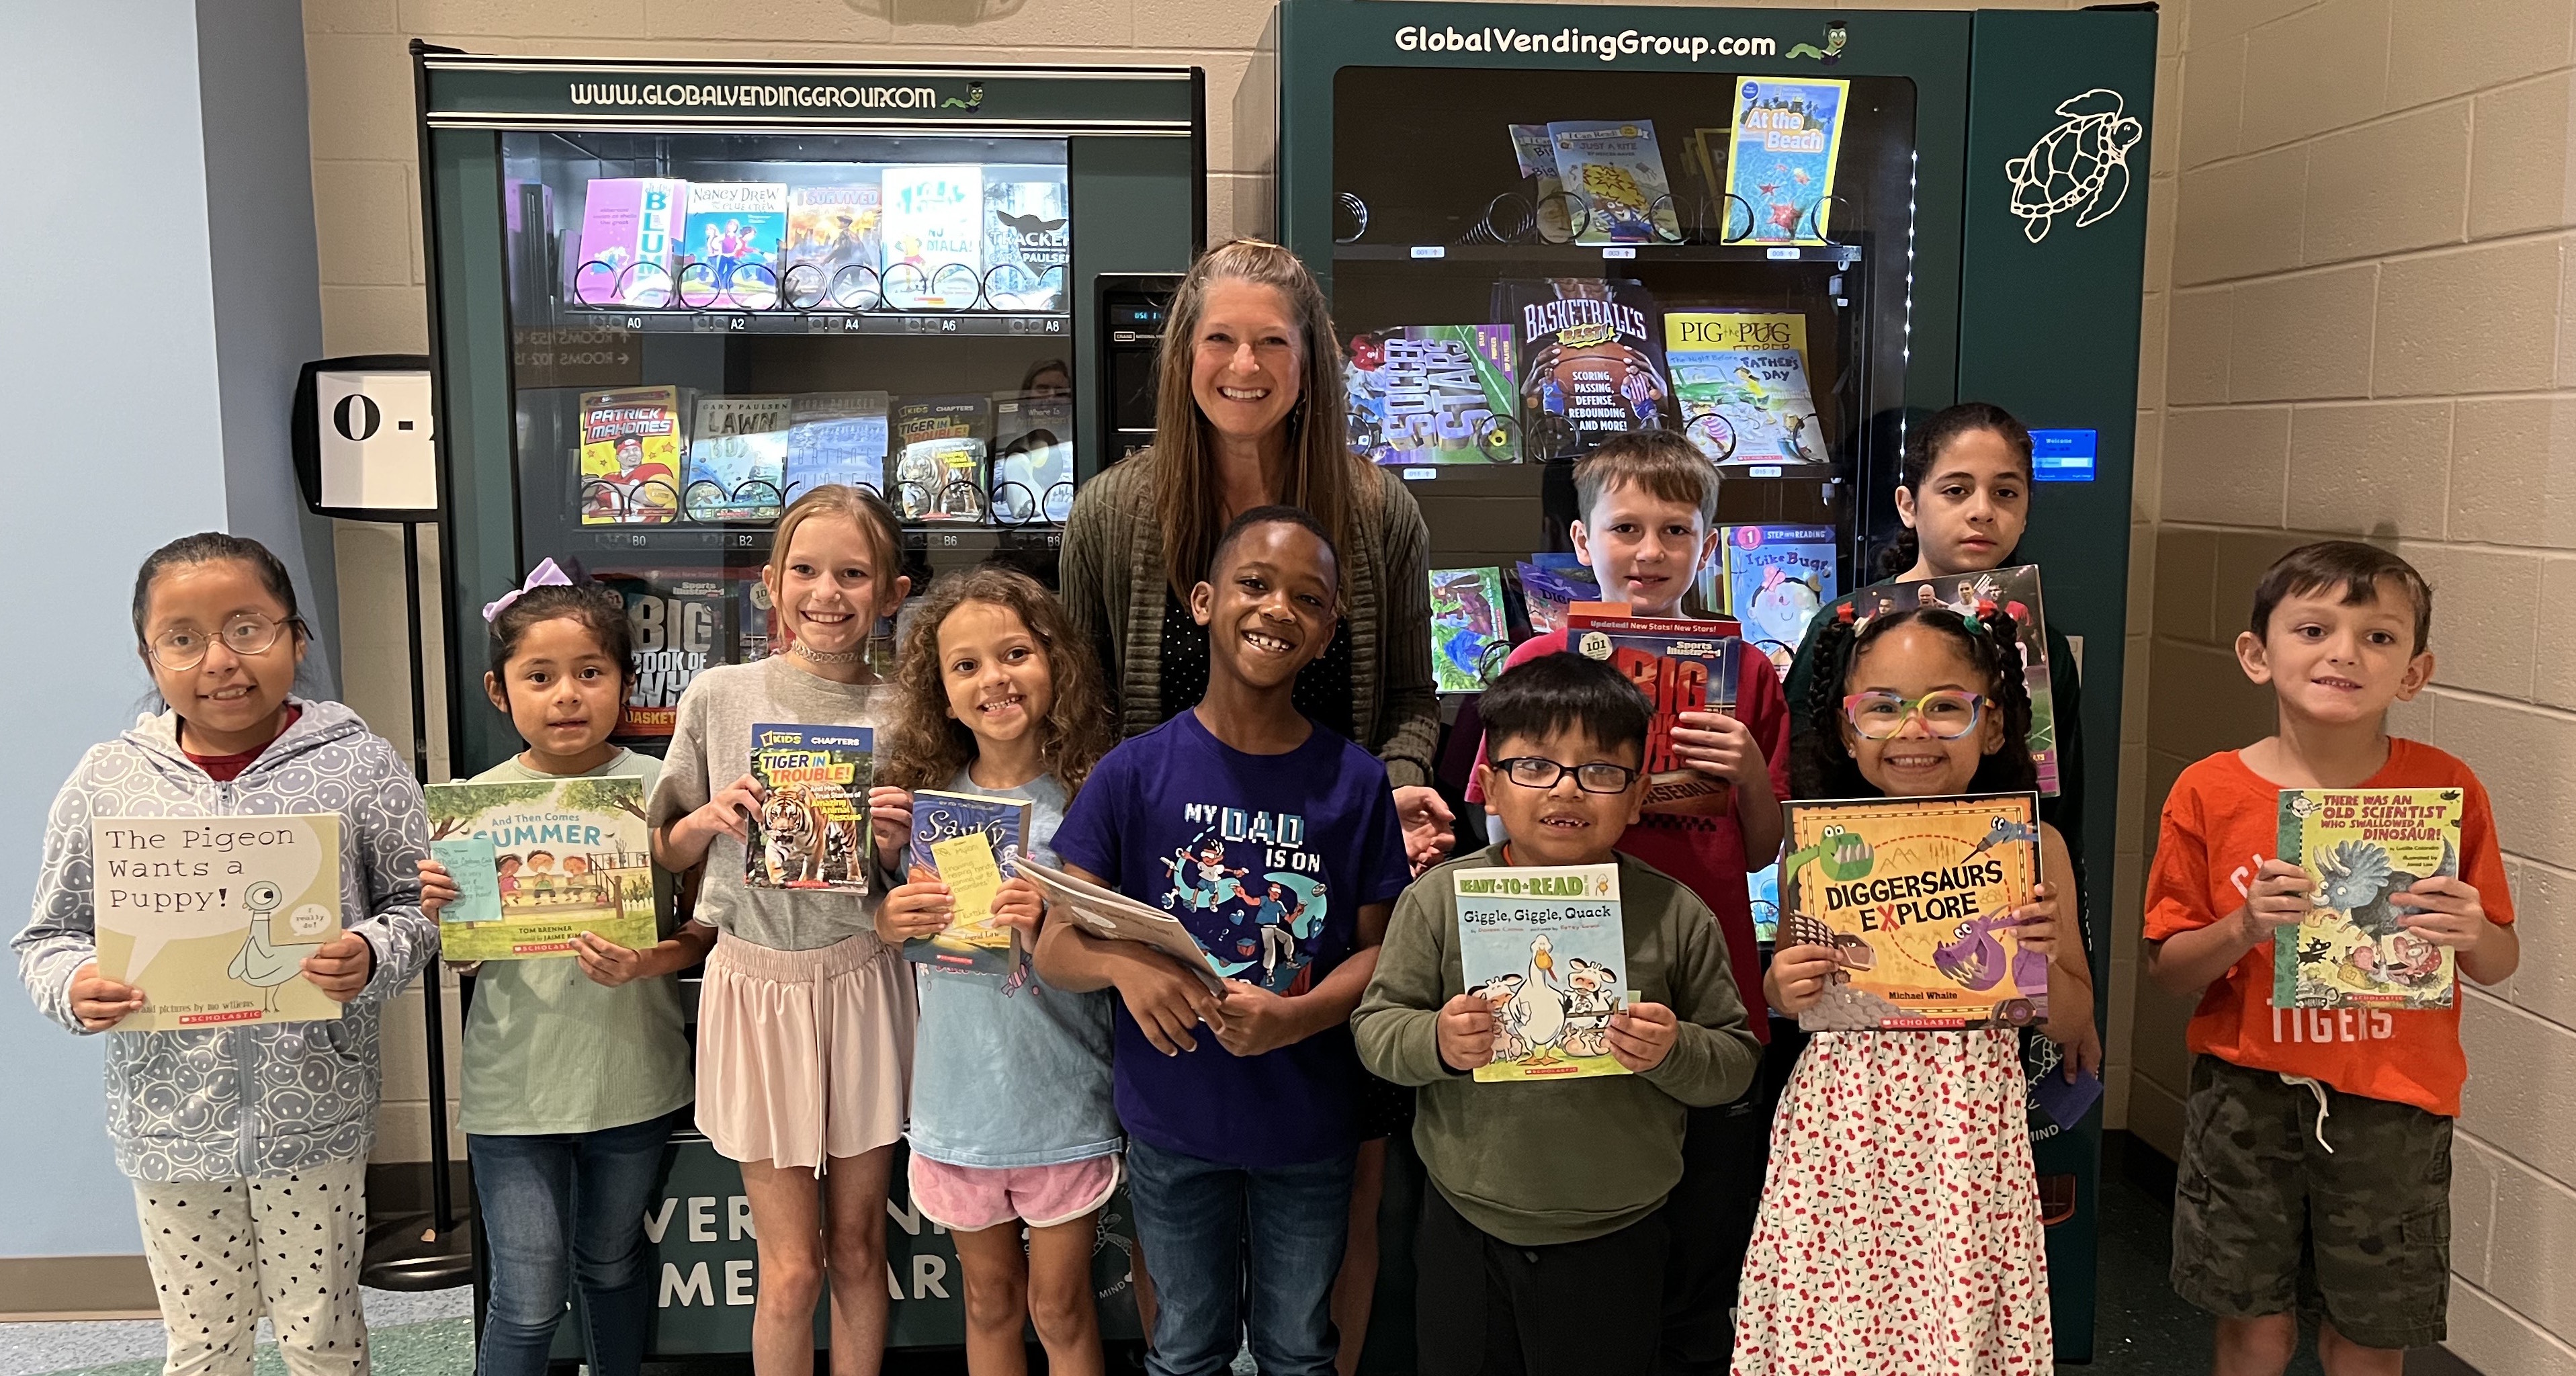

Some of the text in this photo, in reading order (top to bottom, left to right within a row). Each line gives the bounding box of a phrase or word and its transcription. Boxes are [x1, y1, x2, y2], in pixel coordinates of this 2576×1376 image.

[1396, 26, 1776, 61] GlobalVendingGroup.com
[570, 83, 936, 109] WWW.GLOBALVENDINGGROUP.COM
[1748, 112, 1800, 129] At the
[1768, 132, 1820, 149] Beach
[741, 187, 779, 203] DREW
[806, 190, 879, 206] SURVIVED
[990, 253, 1021, 263] GARY
[627, 317, 642, 329] A0
[730, 318, 744, 330] A2
[845, 318, 859, 330] A4
[942, 320, 956, 331] A6
[1045, 320, 1060, 332] A8
[1563, 325, 1608, 344] BEST!
[1680, 322, 1723, 343] PIG
[1739, 322, 1792, 343] PUG
[1688, 354, 1710, 363] Night
[1740, 356, 1799, 370] FATHER'S
[1573, 371, 1613, 382] SCORING,
[1762, 370, 1790, 382] DAY
[1382, 339, 1436, 440] SOCCER
[1421, 339, 1498, 440] STARS
[1574, 383, 1615, 394] PASSING,
[739, 402, 788, 411] PAULSEN
[1576, 395, 1616, 406] DEFENSE,
[590, 408, 660, 425] PATRICK
[1569, 408, 1626, 418] REBOUNDING
[709, 411, 778, 434] LAWN
[900, 419, 948, 436] TIGER IN
[1600, 421, 1628, 431] MORE!
[592, 420, 672, 439] MAHOMES
[905, 425, 967, 442] TROUBLE!
[632, 535, 646, 546] B0
[739, 535, 753, 546] B2
[944, 536, 957, 546] B6
[1747, 531, 1754, 543] 1
[1754, 554, 1785, 566] Like
[682, 582, 716, 590] Sports
[627, 593, 713, 653] BIG
[1590, 620, 1629, 629] Updated!
[1649, 623, 1673, 631] Stats!
[1674, 624, 1690, 632] New
[1692, 625, 1717, 633] Stars!
[1586, 642, 1606, 652] 101
[1676, 641, 1713, 650] Sports
[687, 652, 707, 671] OF
[773, 734, 860, 746] KIDS CHAPTERS
[763, 755, 826, 769] TIGER IN
[771, 766, 851, 783] TROUBLE!
[1641, 781, 1721, 806] ASEBALL
[811, 800, 847, 808] Amazing
[2323, 795, 2412, 806] THERE WAS AN
[820, 806, 850, 814] Animal
[2323, 806, 2447, 819] OLD SCIENTIST
[492, 812, 580, 826] And Then Comes
[828, 814, 862, 822] Rescues
[2321, 818, 2425, 828] WHO SWALLOWED A
[1185, 803, 1304, 849] MY DAD
[106, 826, 296, 852] The Pigeon
[2362, 826, 2442, 841] DINOSAUR!
[1266, 848, 1320, 873] IS ON
[108, 859, 245, 878] Wants a
[1460, 876, 1584, 896] READY TO READ
[1825, 860, 2004, 911] DIGGERSAURS
[110, 888, 228, 913] Puppy!
[1464, 905, 1611, 926] Giggle, Giggle, Quack
[1859, 892, 1980, 933] EXPLORE
[295, 914, 325, 924] really
[302, 921, 317, 929] do!
[518, 924, 573, 935] TOM BRENNER
[965, 930, 1000, 941] Ingrid Law
[543, 933, 566, 942] JAIME
[1889, 991, 1958, 1000] Michael Whaite
[159, 1004, 191, 1015] pictures
[194, 1003, 204, 1013] by
[191, 1010, 261, 1023] SCHOLASTIC
[1892, 1018, 1965, 1026] SCHOLASTIC
[1099, 1281, 1126, 1299] MIND
